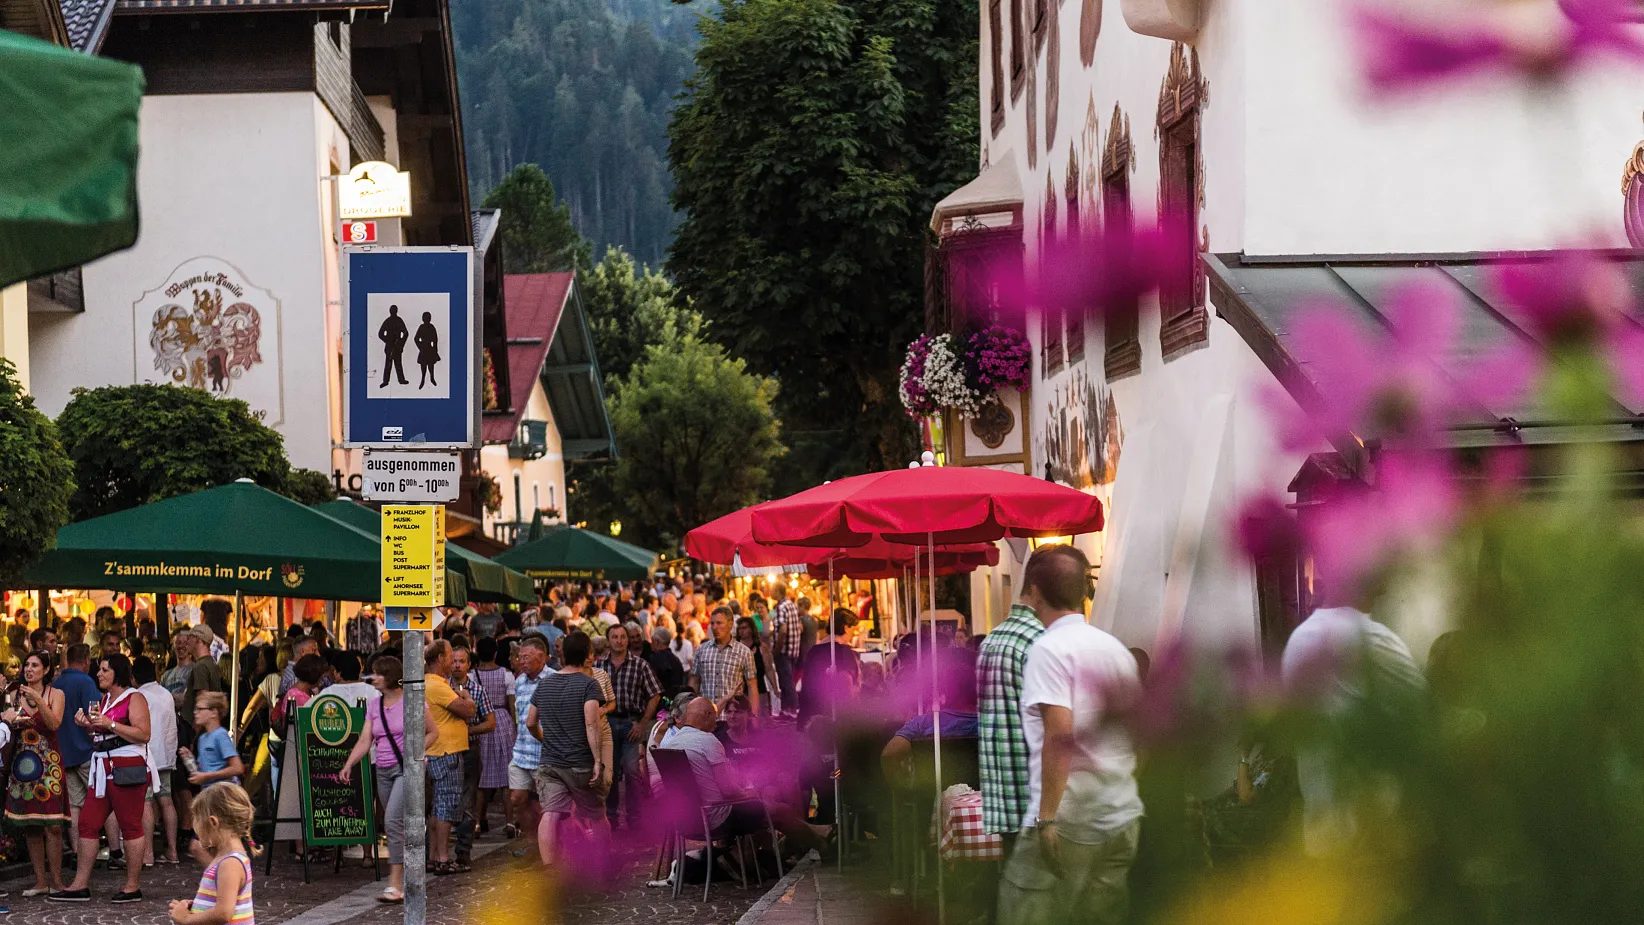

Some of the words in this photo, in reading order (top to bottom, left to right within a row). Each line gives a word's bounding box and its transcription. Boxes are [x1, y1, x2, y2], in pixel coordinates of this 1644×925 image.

[164, 273, 202, 298] Wappen
[203, 271, 216, 283] der
[215, 272, 243, 298] Familie
[367, 459, 456, 474] ausgenommen
[373, 480, 395, 492] von
[104, 561, 212, 577] Z'sammkemma
[215, 564, 234, 578] im
[238, 565, 273, 581] Dorf
[314, 808, 332, 818] AUCH
[316, 818, 331, 828] ZUM
[324, 827, 343, 837] TAKE
[344, 826, 364, 836] AWAY
